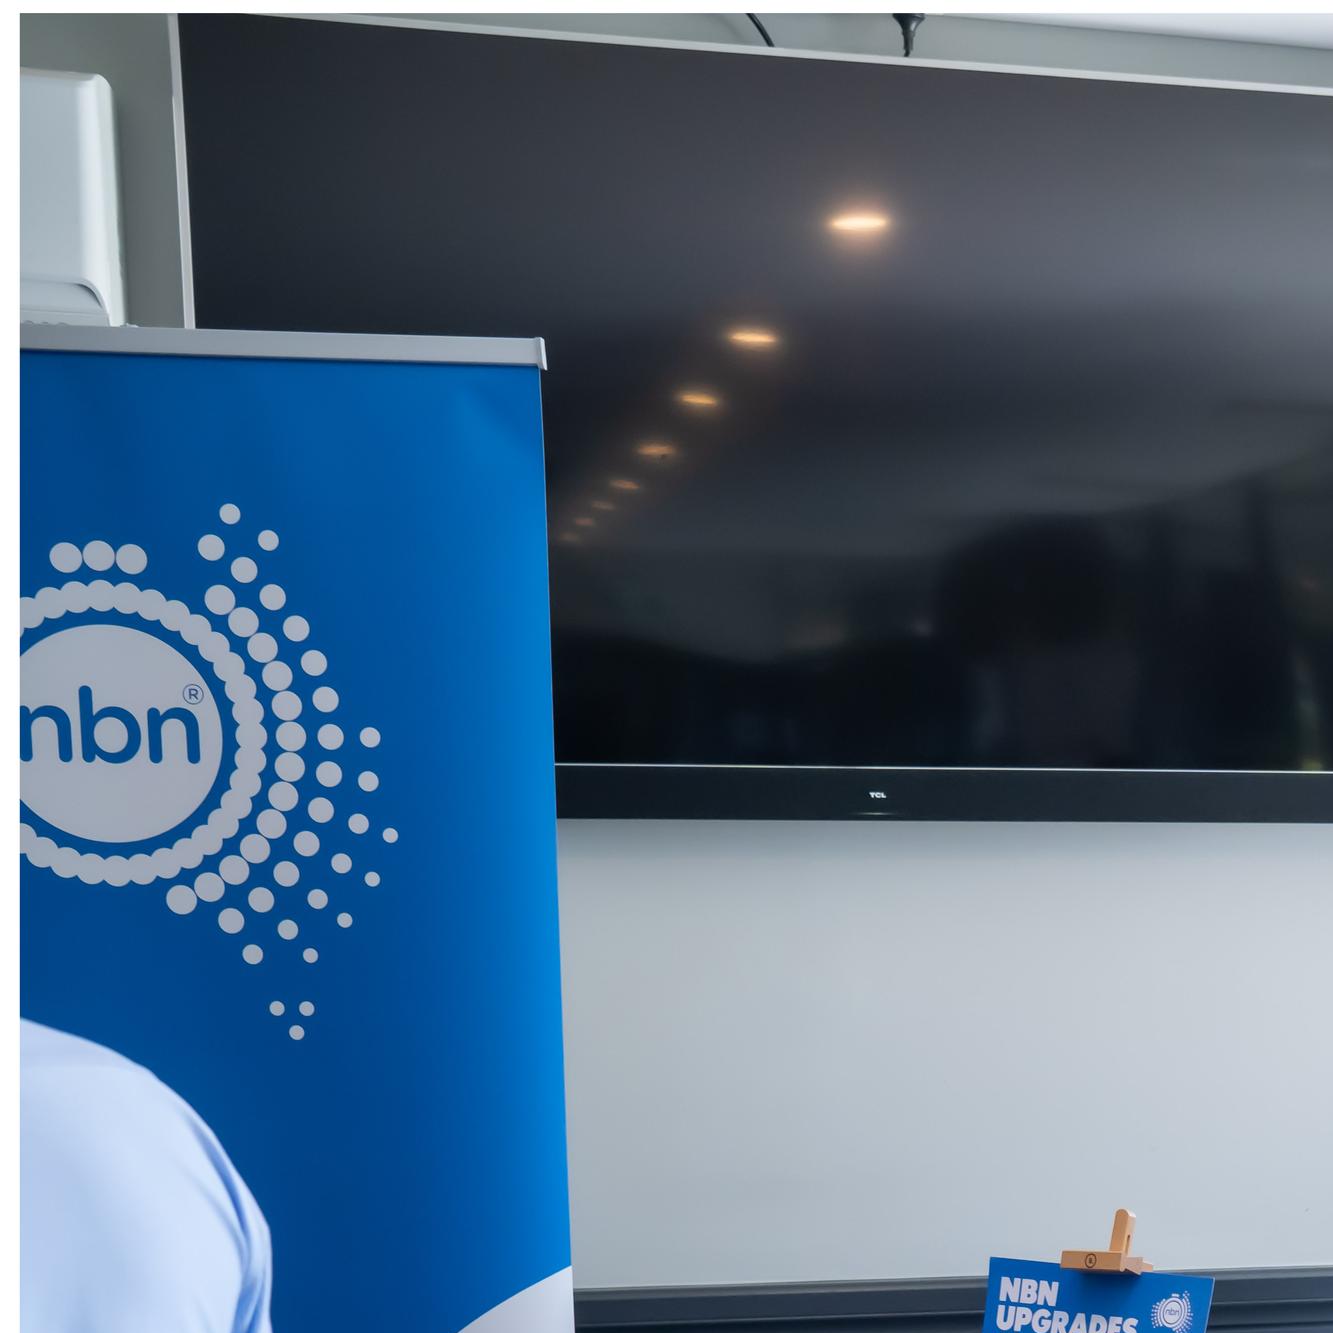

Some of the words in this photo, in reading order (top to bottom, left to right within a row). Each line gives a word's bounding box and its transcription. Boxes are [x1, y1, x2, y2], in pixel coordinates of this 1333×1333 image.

[20, 685, 201, 765] nbn
[1000, 1276, 1059, 1306] NBN
[1165, 1306, 1180, 1318] nbn
